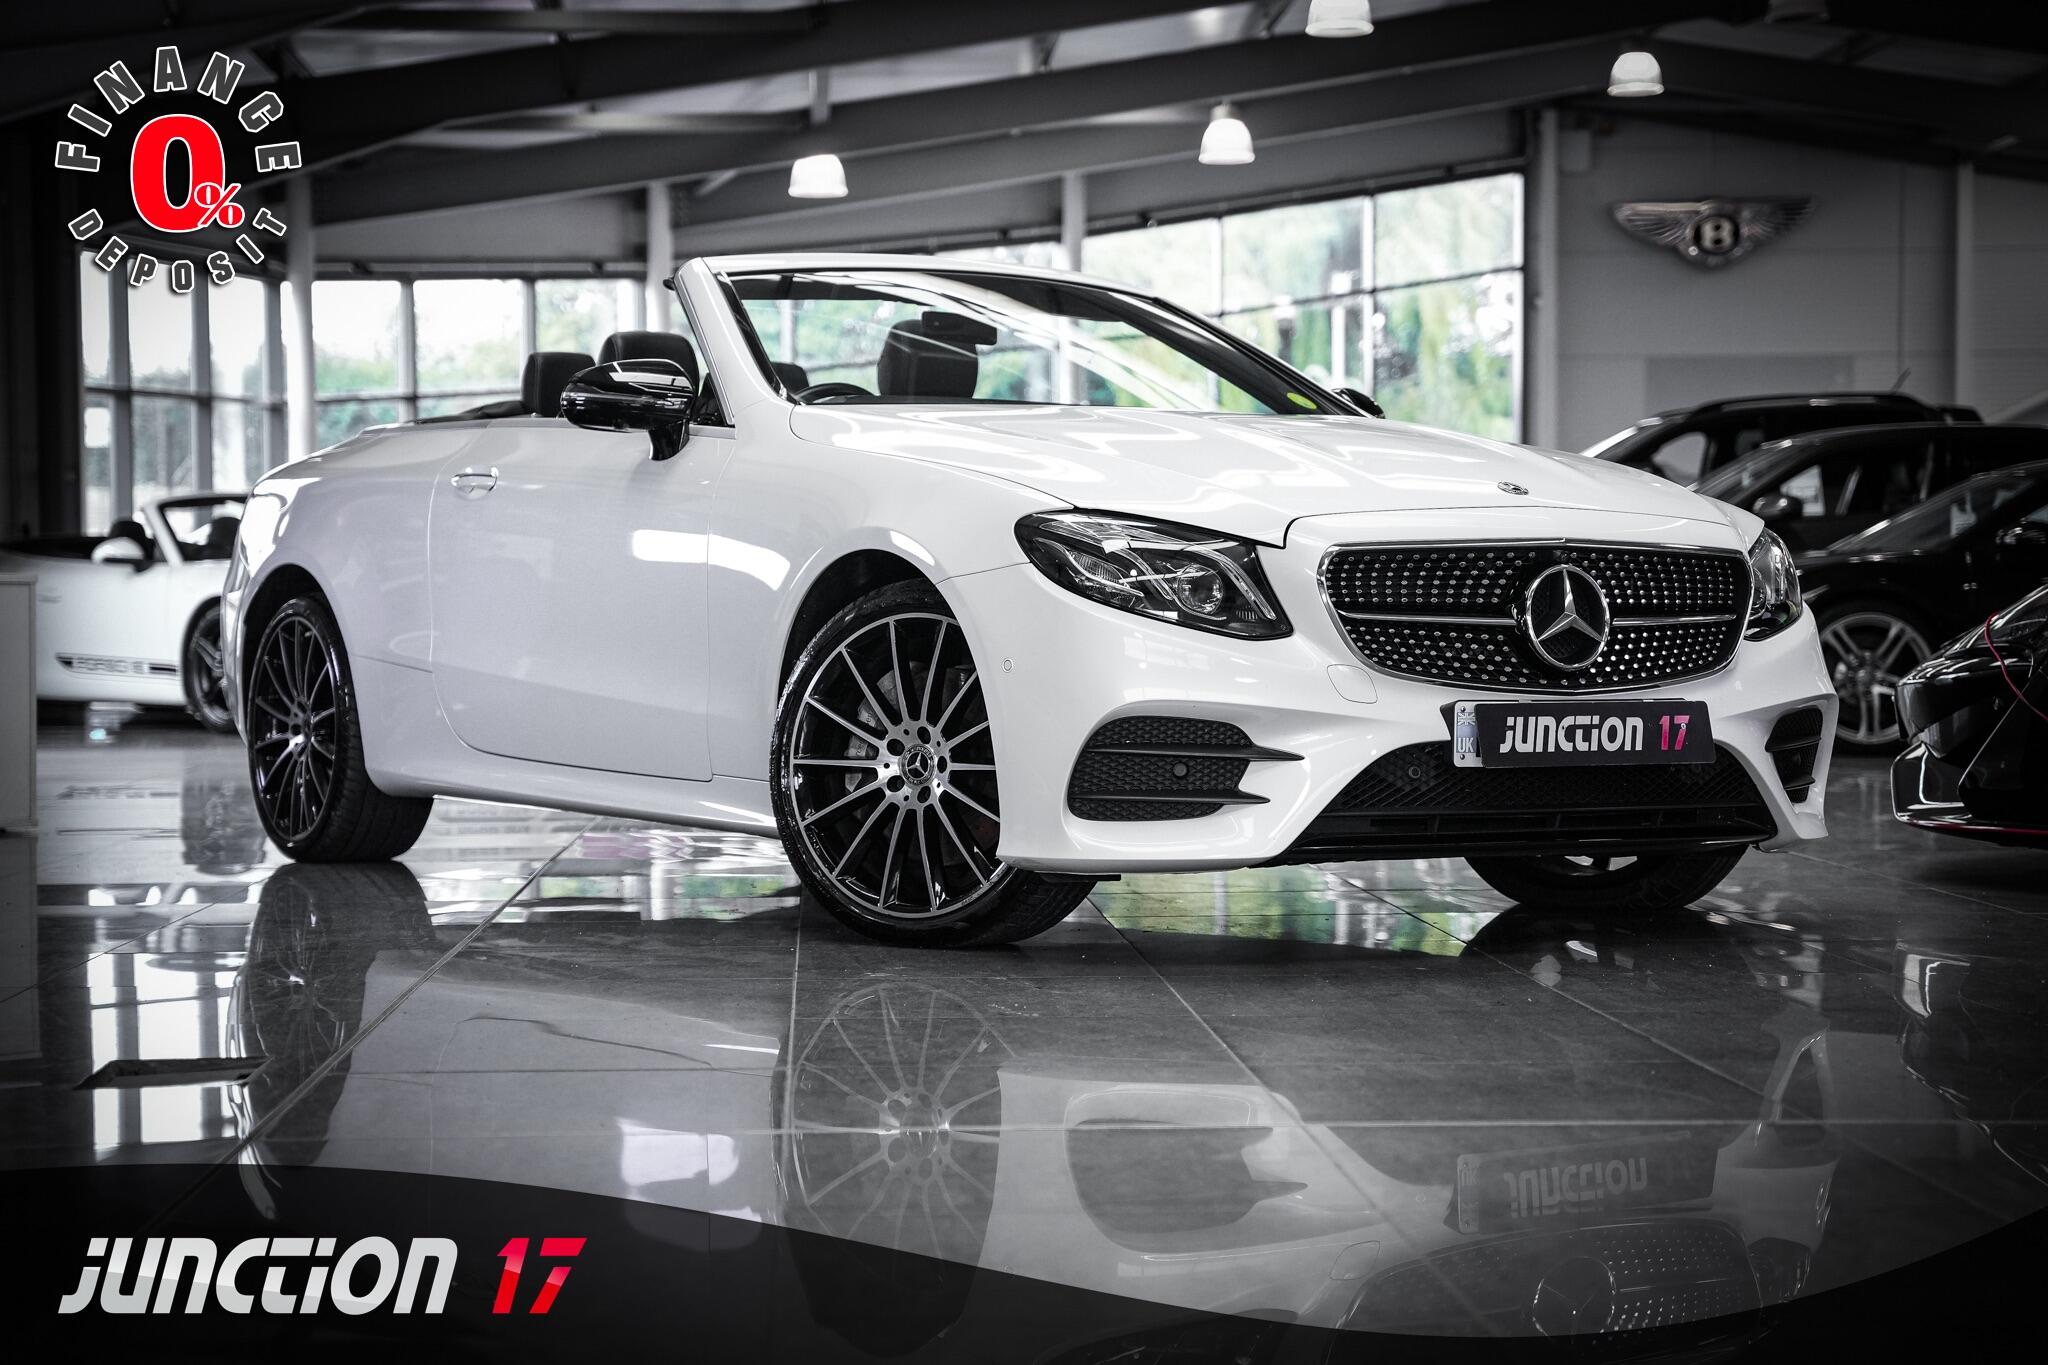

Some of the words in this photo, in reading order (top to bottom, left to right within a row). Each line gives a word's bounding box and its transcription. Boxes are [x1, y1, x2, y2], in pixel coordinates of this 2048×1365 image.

[1701, 216, 1735, 250] B
[1457, 737, 1474, 753] UK
[1659, 715, 1690, 751] 17
